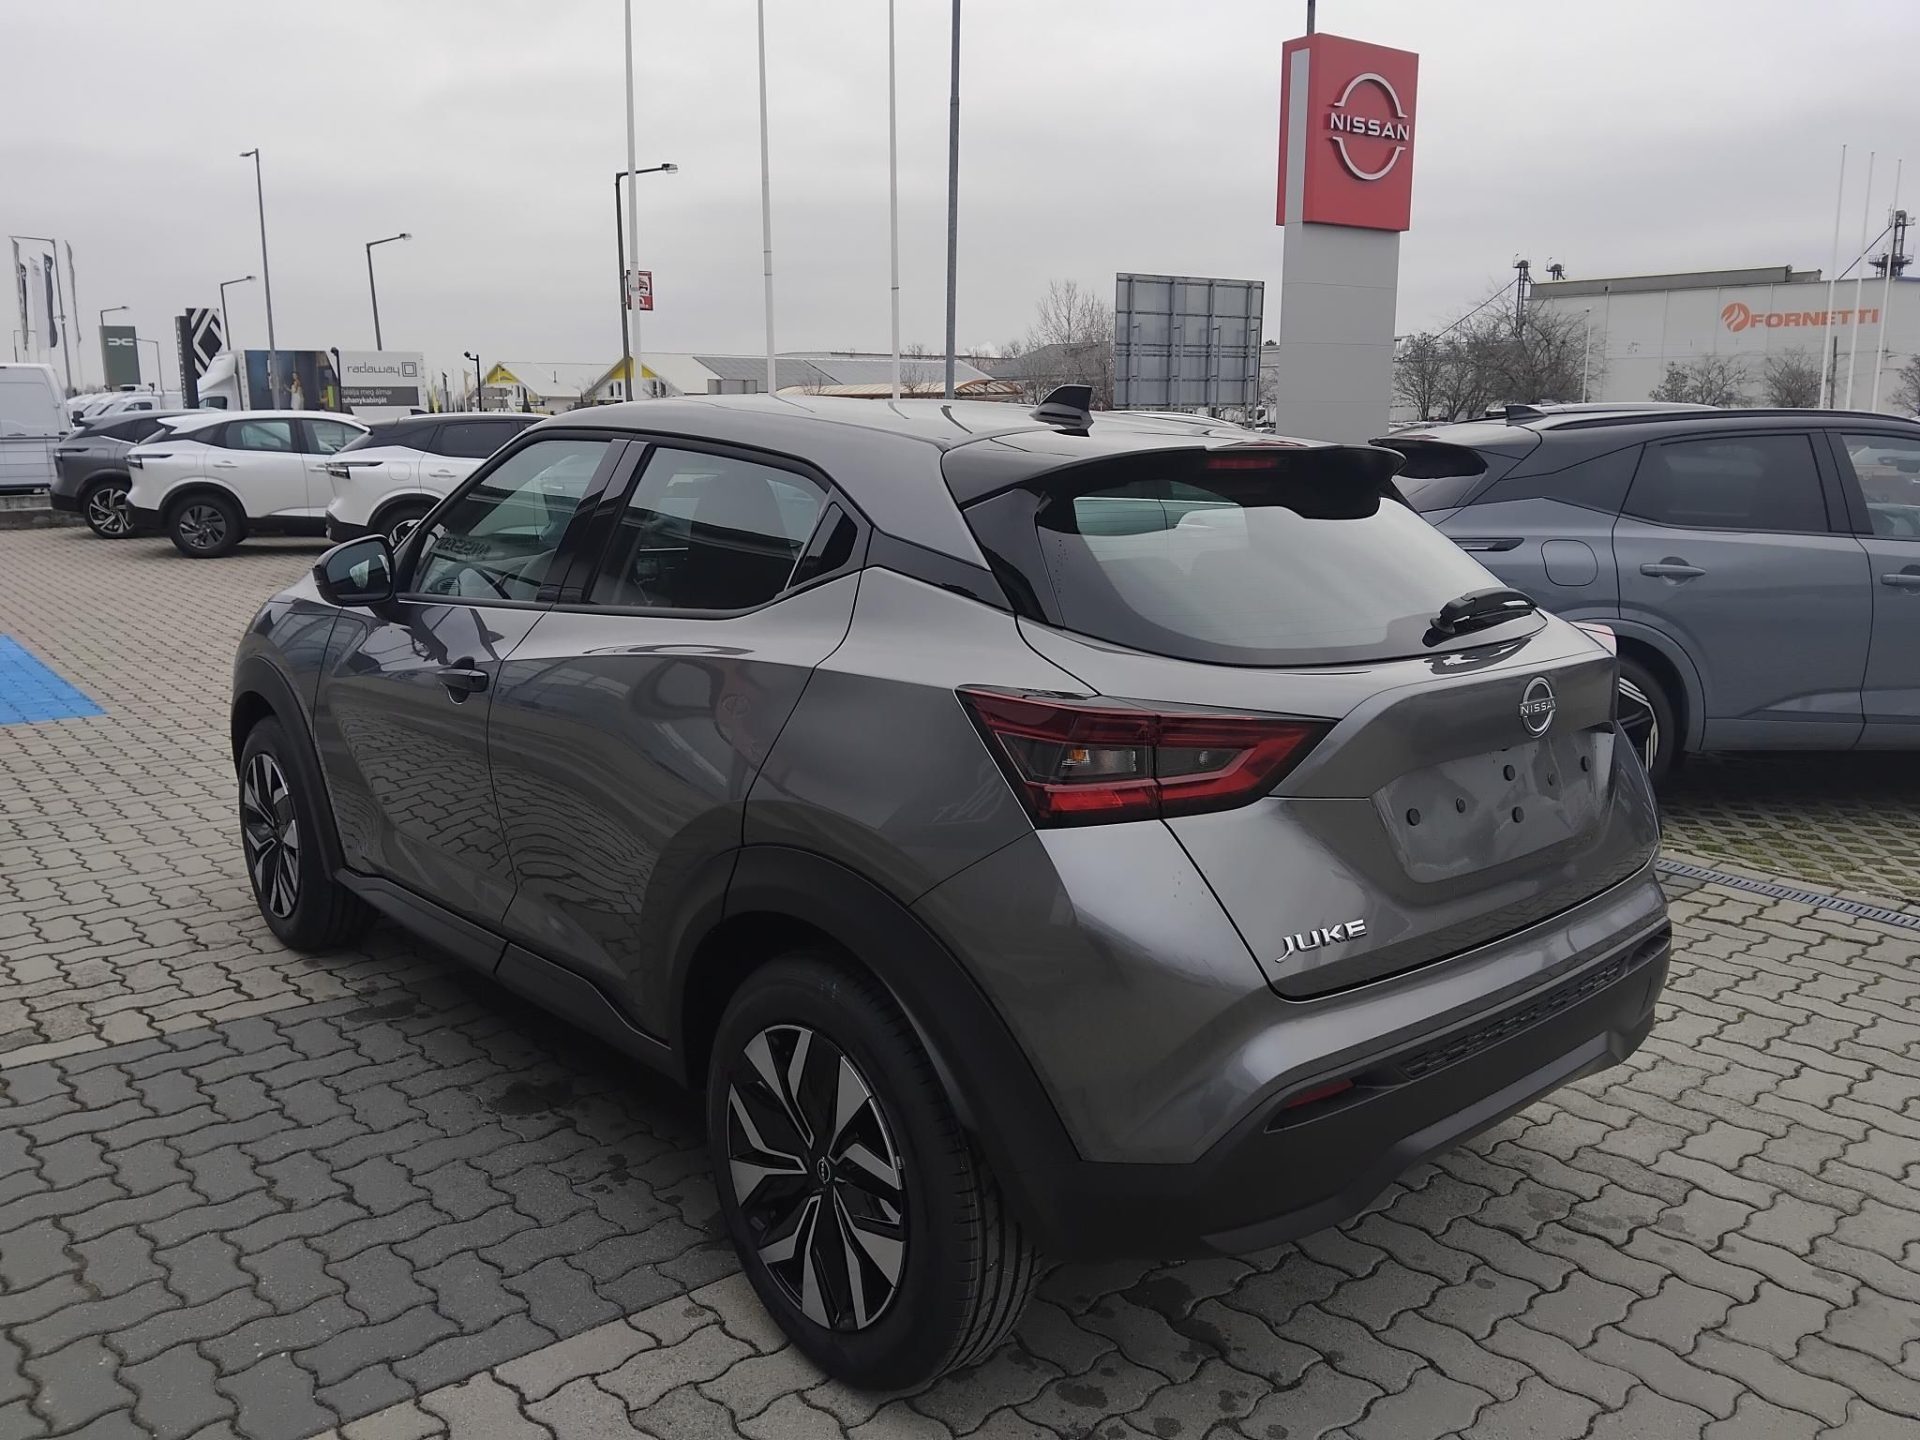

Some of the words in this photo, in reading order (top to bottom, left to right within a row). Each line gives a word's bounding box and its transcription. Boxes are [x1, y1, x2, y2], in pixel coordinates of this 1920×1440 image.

[1330, 112, 1410, 141] NISSAN
[1750, 308, 1879, 328] FORNETTI
[346, 361, 401, 377] radaway
[1520, 700, 1556, 715] NISSAN
[1275, 919, 1367, 964] JUKE
